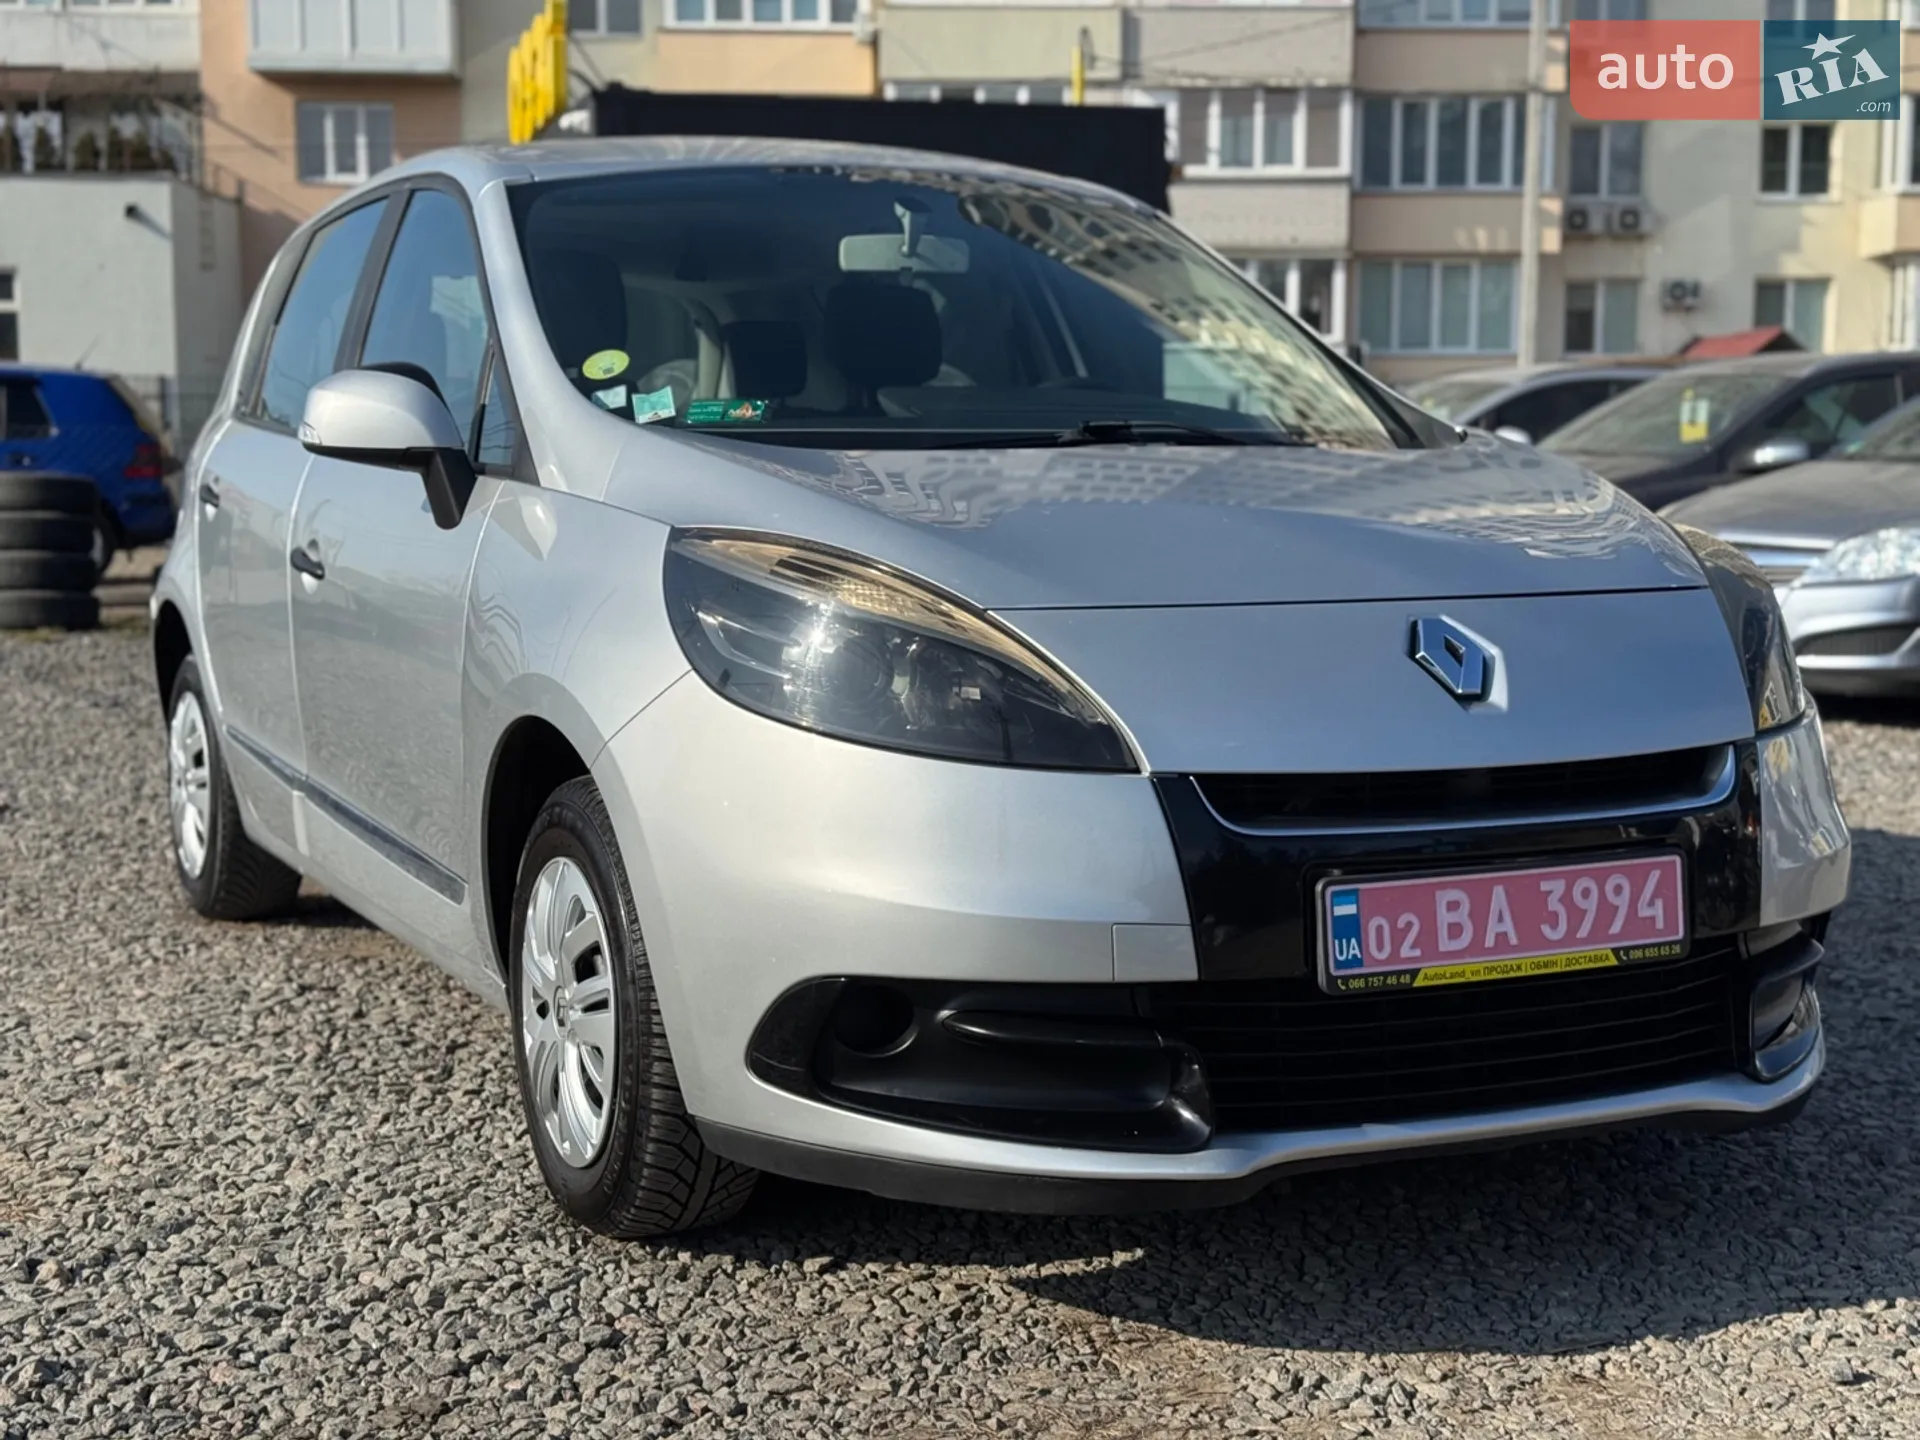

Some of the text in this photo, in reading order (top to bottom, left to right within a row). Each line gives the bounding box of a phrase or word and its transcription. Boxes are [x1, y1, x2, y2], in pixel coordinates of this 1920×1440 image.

[1367, 912, 1422, 961] 02
[1539, 869, 1665, 941] 3994
[1335, 938, 1362, 961] UA
[1482, 962, 1524, 977] ПРОДАЖ
[1564, 953, 1611, 968] ДОСТАВКА
[1348, 973, 1411, 989] 066 757 46 48
